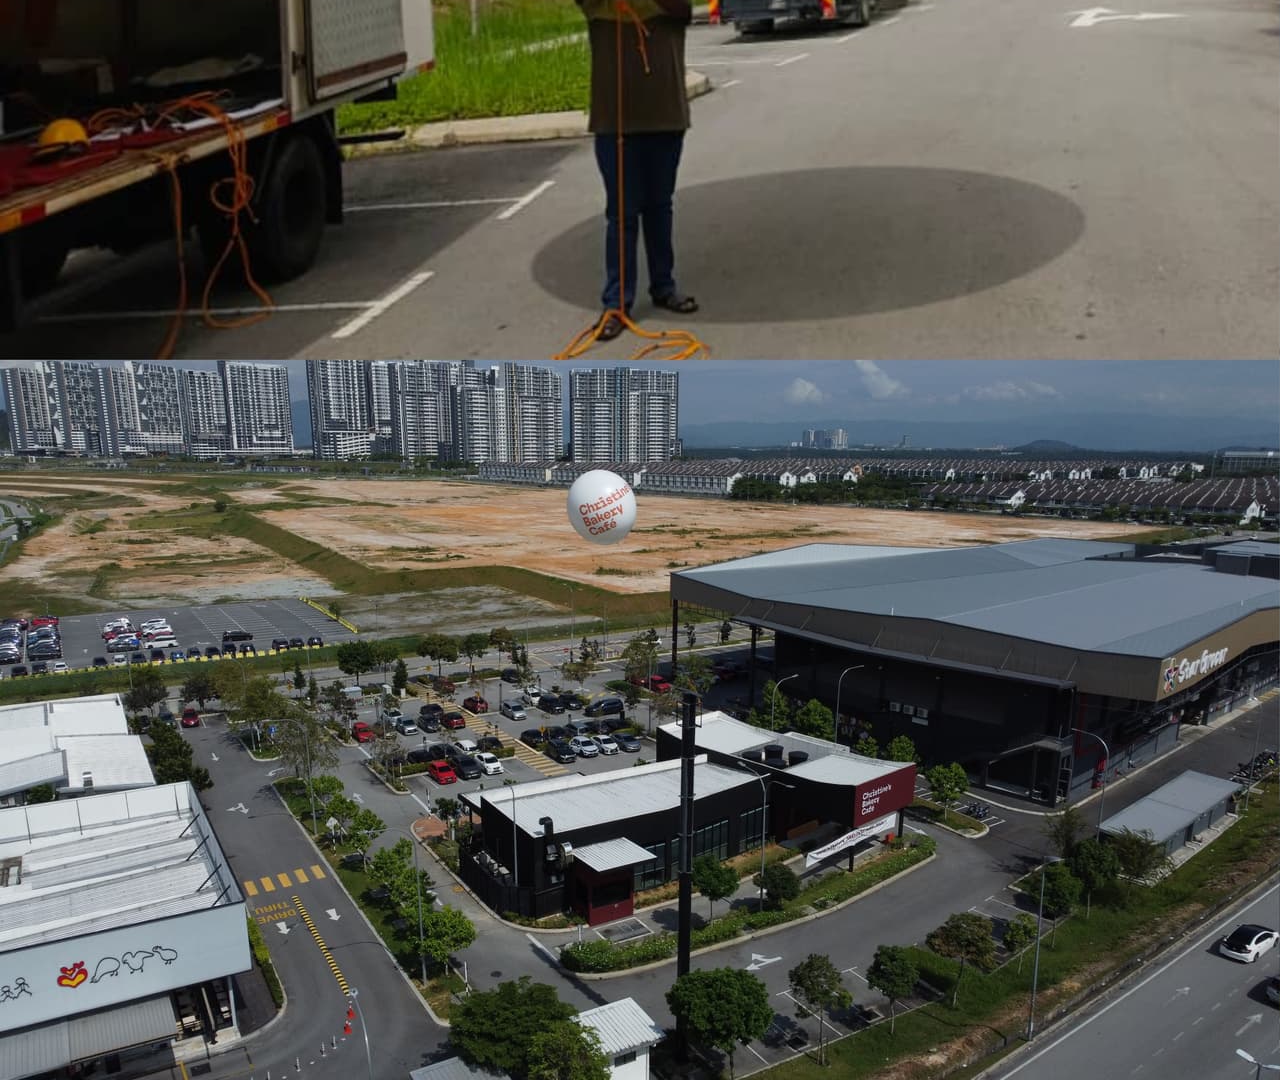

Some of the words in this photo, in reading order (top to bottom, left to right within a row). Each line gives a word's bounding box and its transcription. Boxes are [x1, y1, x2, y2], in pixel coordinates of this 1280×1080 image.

[582, 504, 624, 527] Bakery
[588, 518, 617, 535] Café
[862, 783, 891, 800] Christine's
[861, 805, 875, 815] Café
[257, 909, 297, 925] DRIVE
